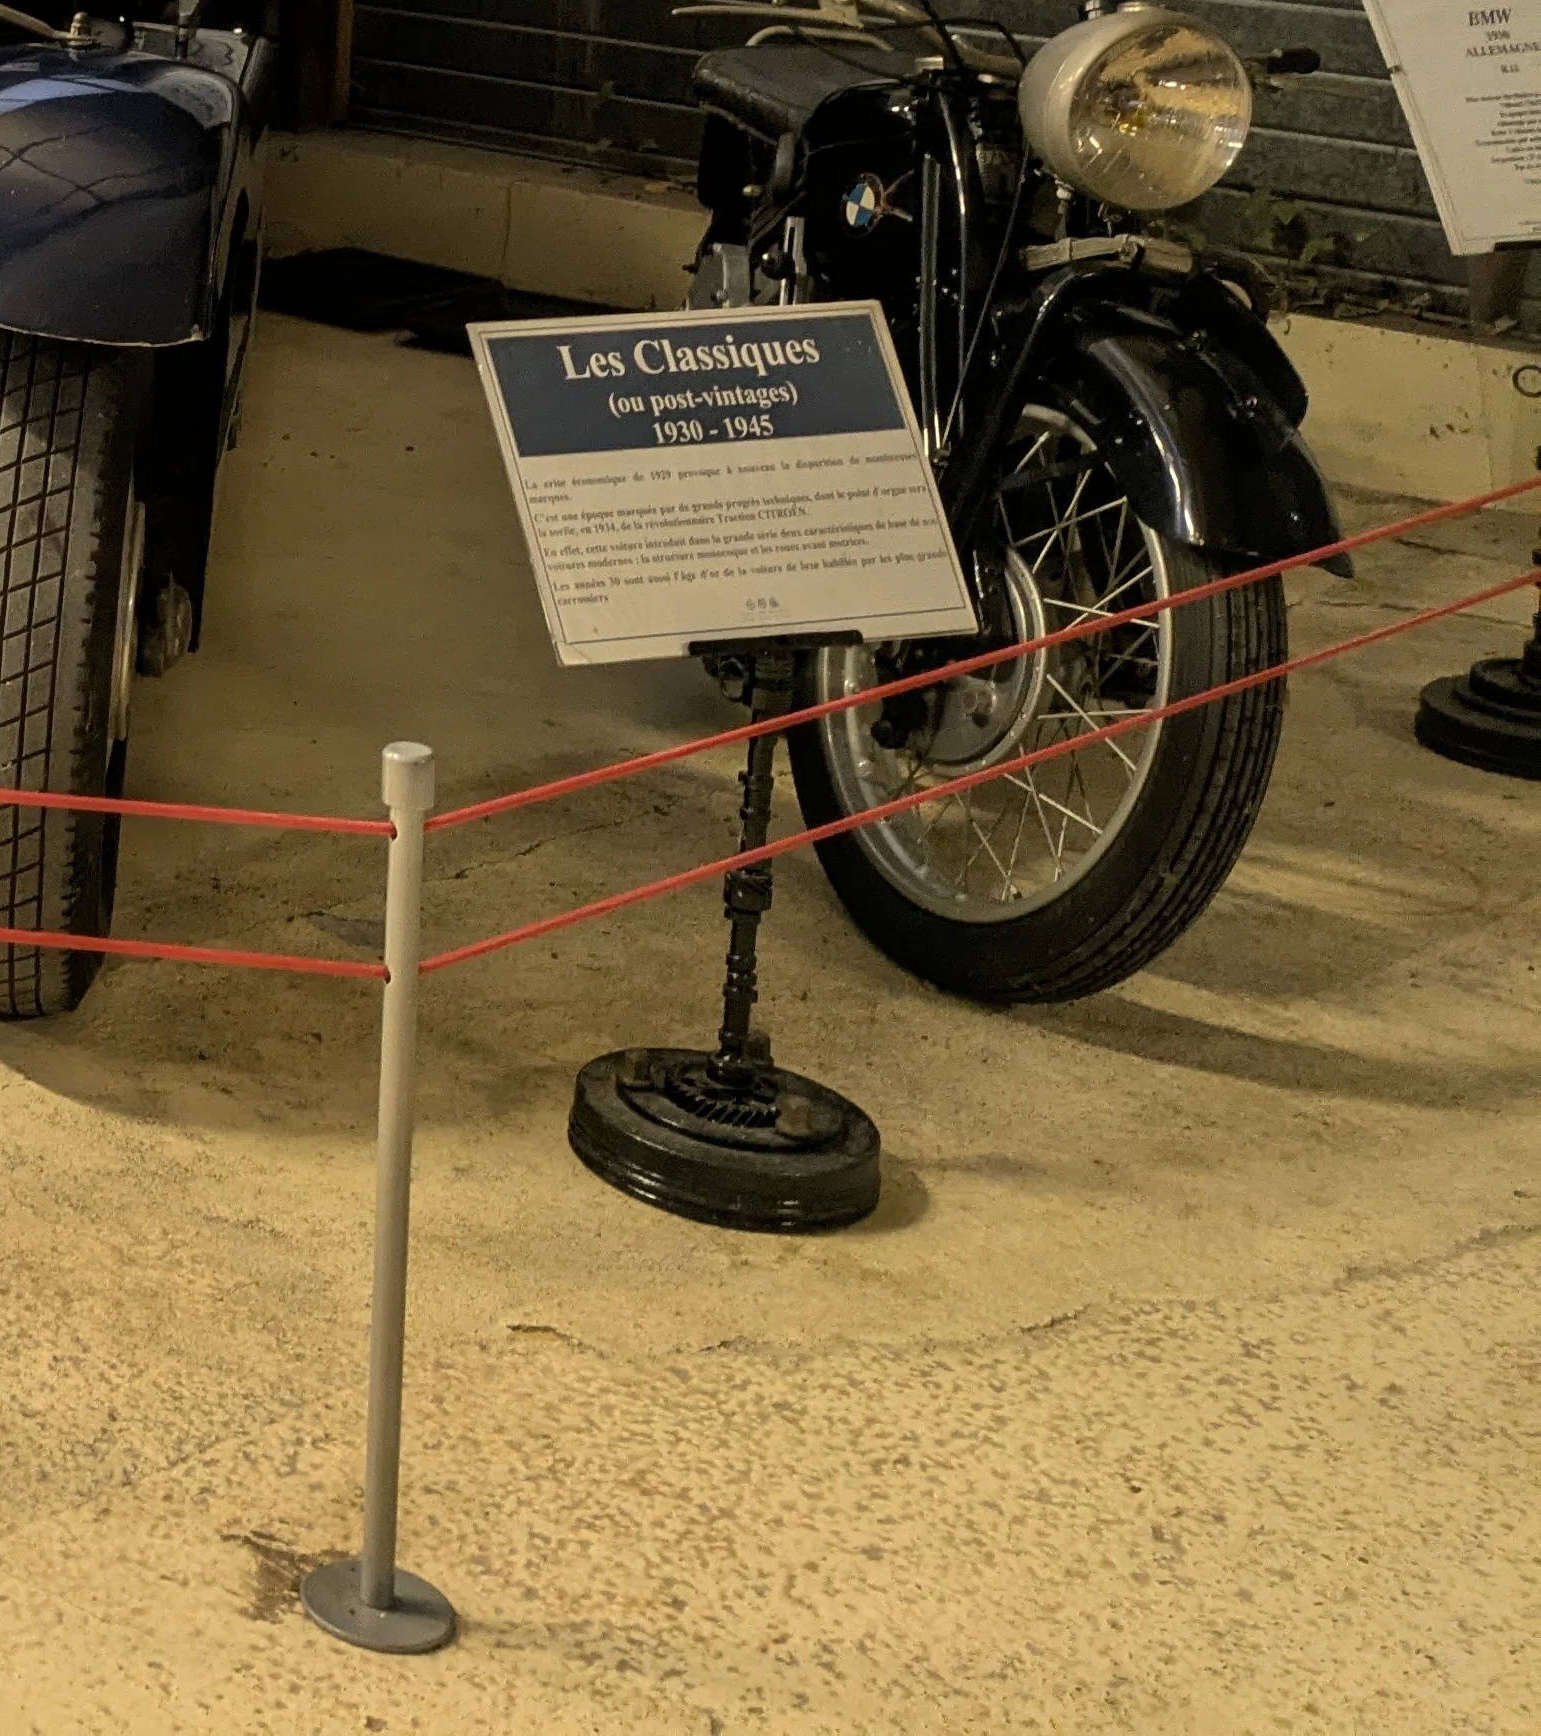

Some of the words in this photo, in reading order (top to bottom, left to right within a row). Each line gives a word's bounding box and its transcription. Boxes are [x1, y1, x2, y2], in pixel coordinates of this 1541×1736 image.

[1469, 8, 1512, 26] BMW
[557, 344, 625, 380] Les
[633, 334, 820, 376] Classiques
[608, 392, 645, 418] (ou
[650, 380, 799, 416] post-vintages)
[652, 419, 704, 444] 1930
[723, 415, 774, 440] 1945
